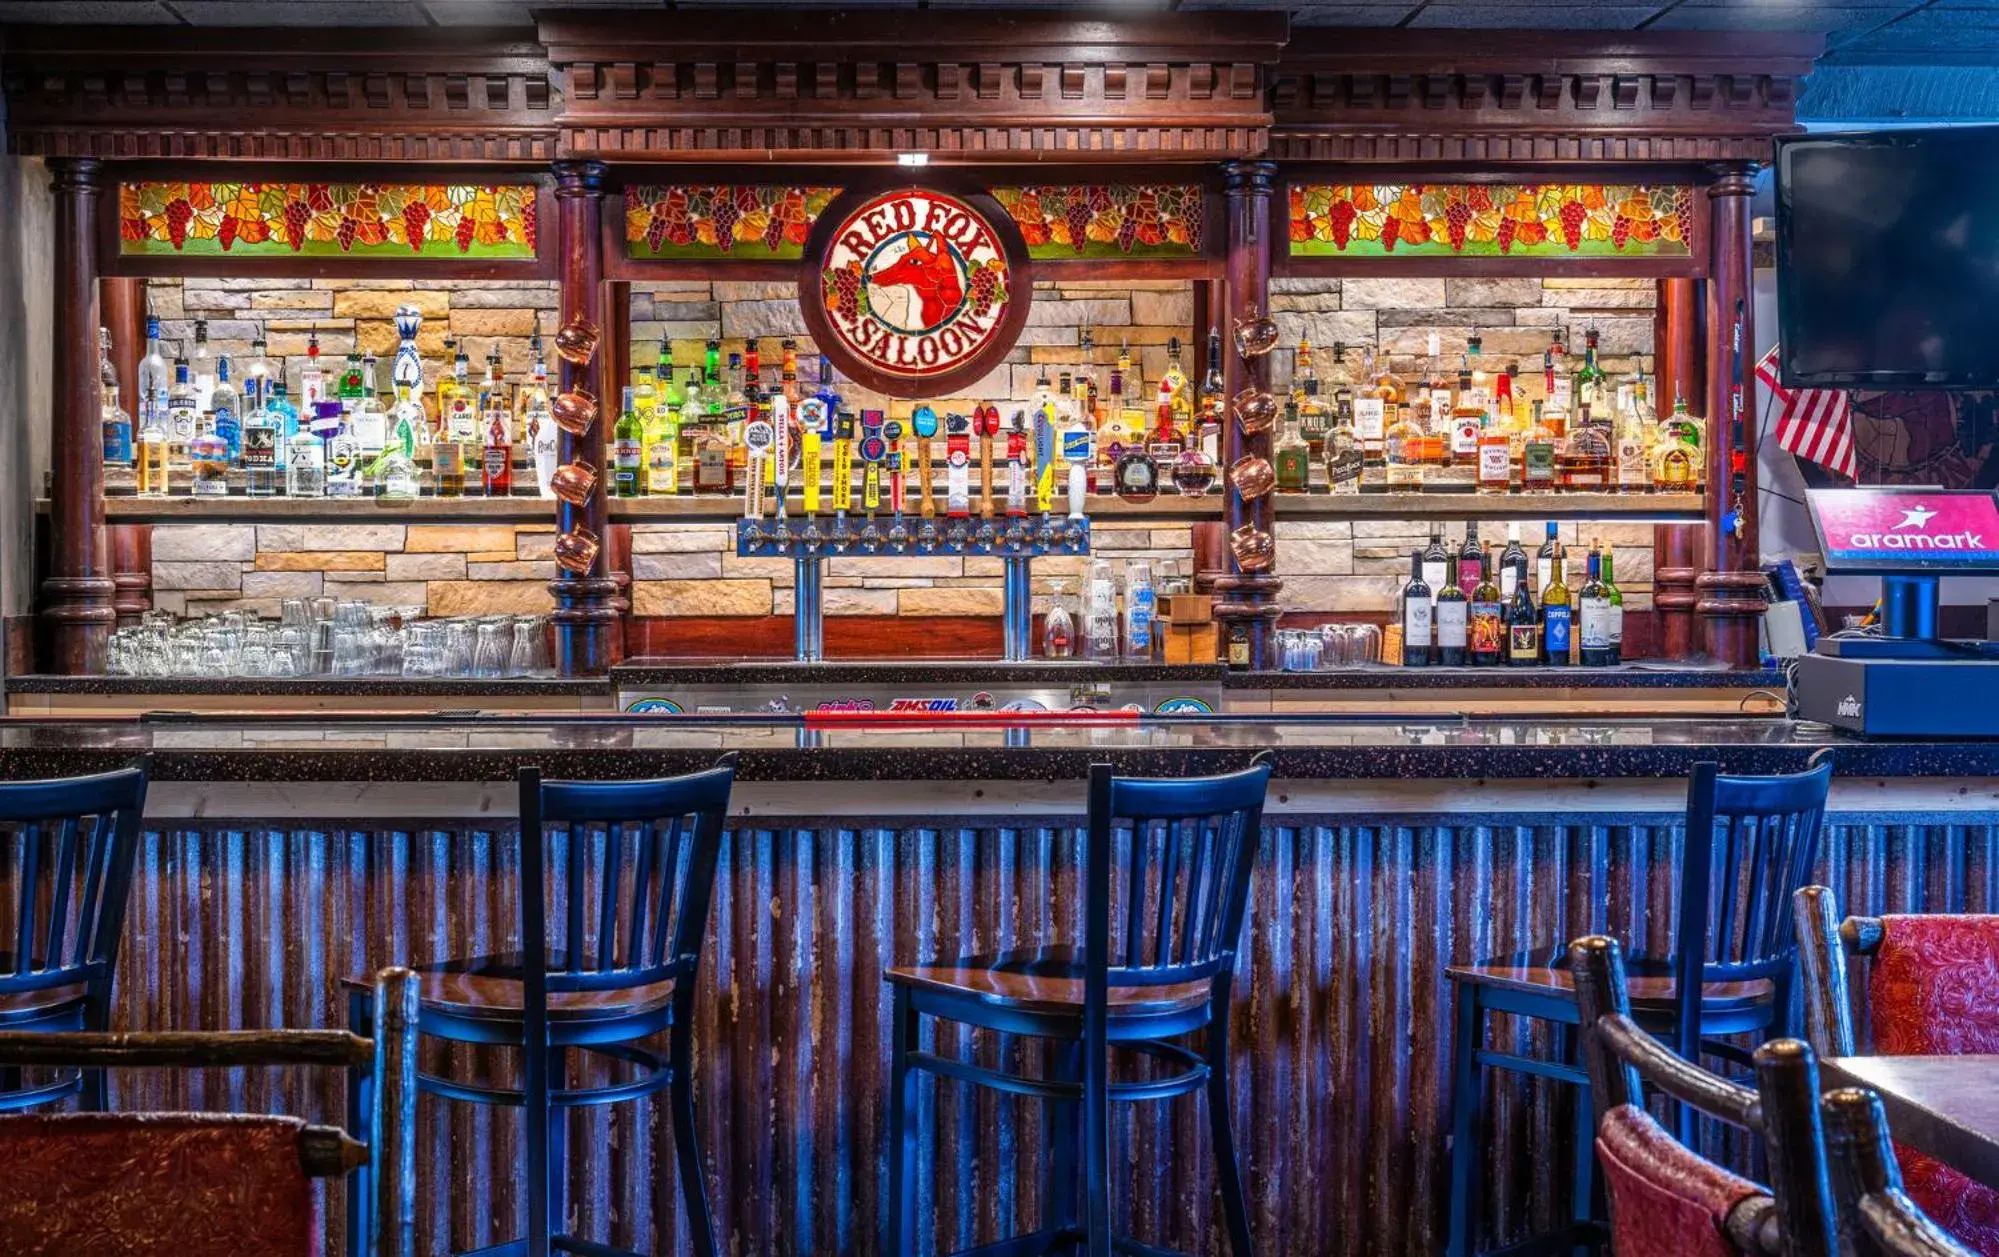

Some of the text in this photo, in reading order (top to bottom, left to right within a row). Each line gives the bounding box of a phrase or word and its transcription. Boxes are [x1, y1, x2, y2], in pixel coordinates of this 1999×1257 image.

[839, 199, 991, 262] RED FOX
[846, 308, 988, 368] SALOON
[1301, 416, 1326, 428] KNOB
[1850, 531, 1986, 549] aramark
[892, 699, 956, 711] AMSOIL
